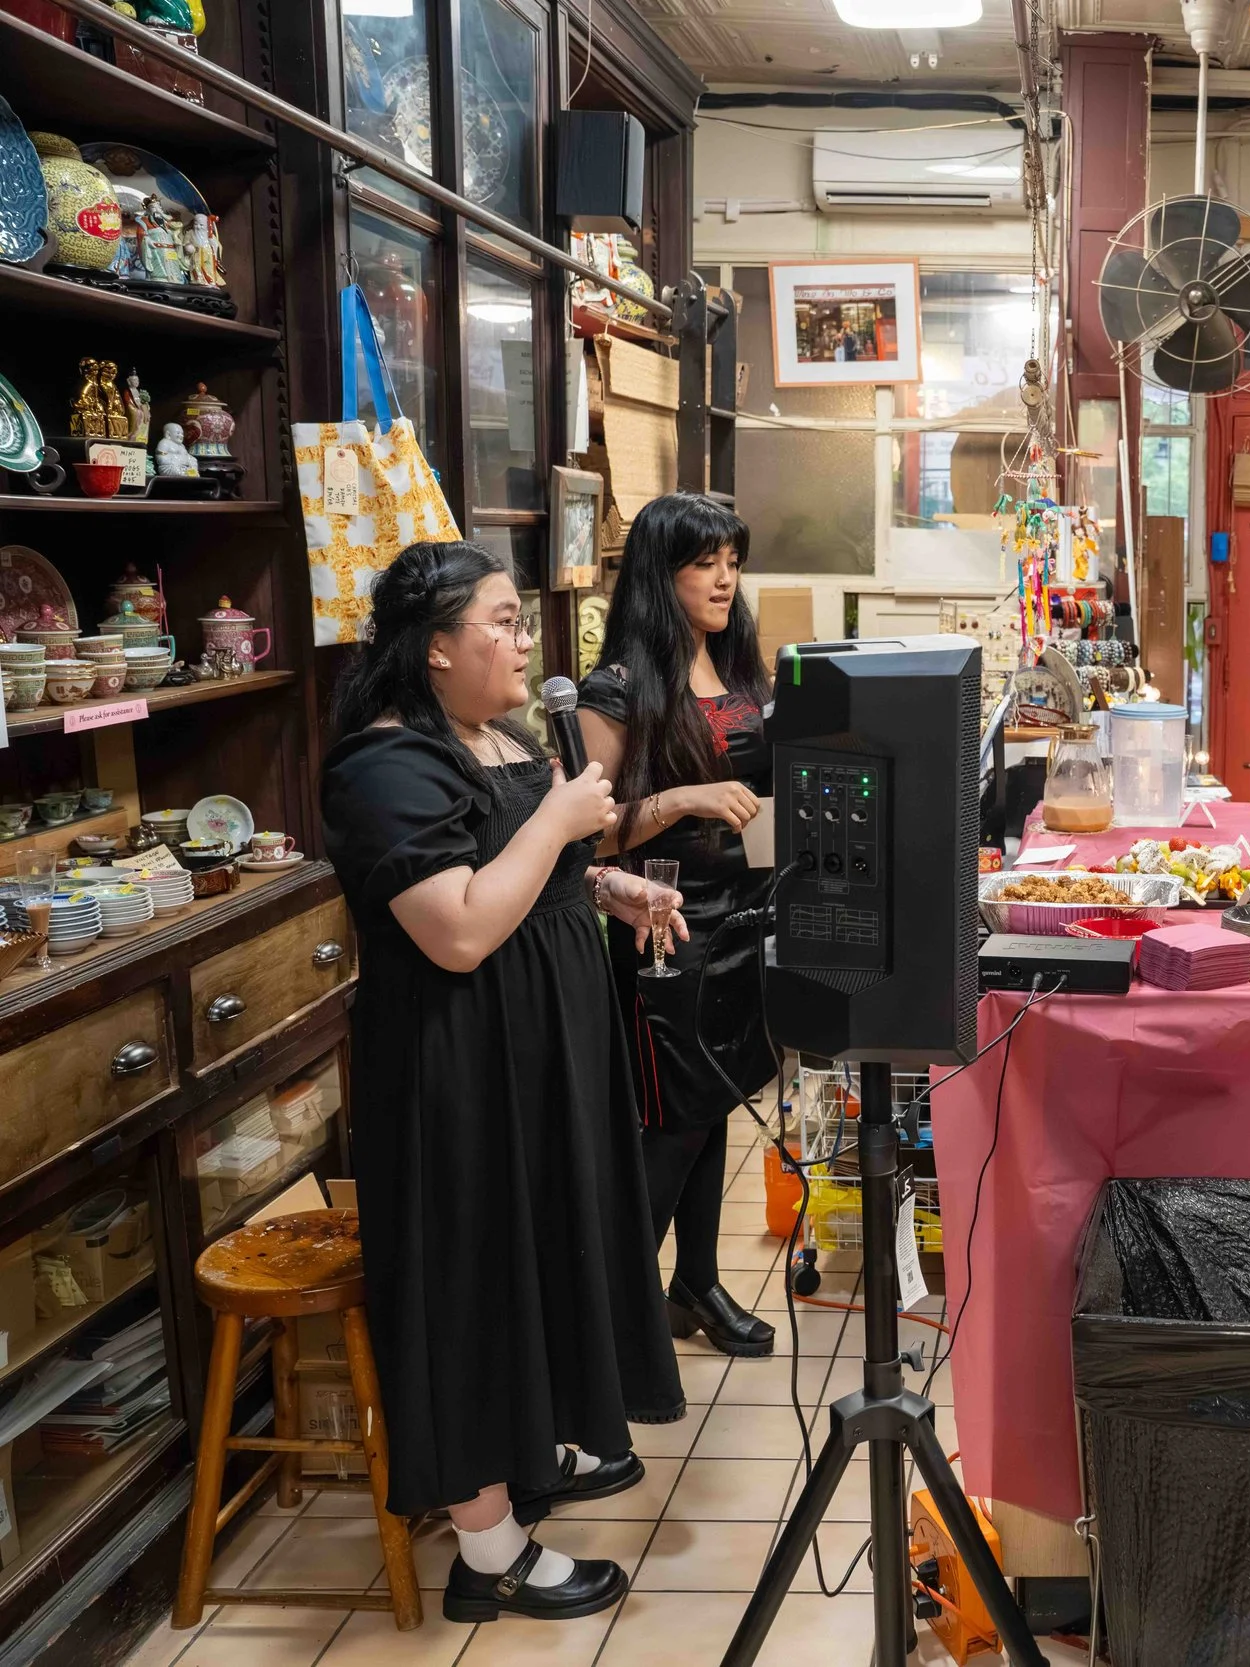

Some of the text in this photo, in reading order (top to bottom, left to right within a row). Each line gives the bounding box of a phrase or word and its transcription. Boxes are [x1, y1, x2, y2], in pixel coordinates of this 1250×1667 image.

[79, 706, 134, 723] Please ask for assistance
